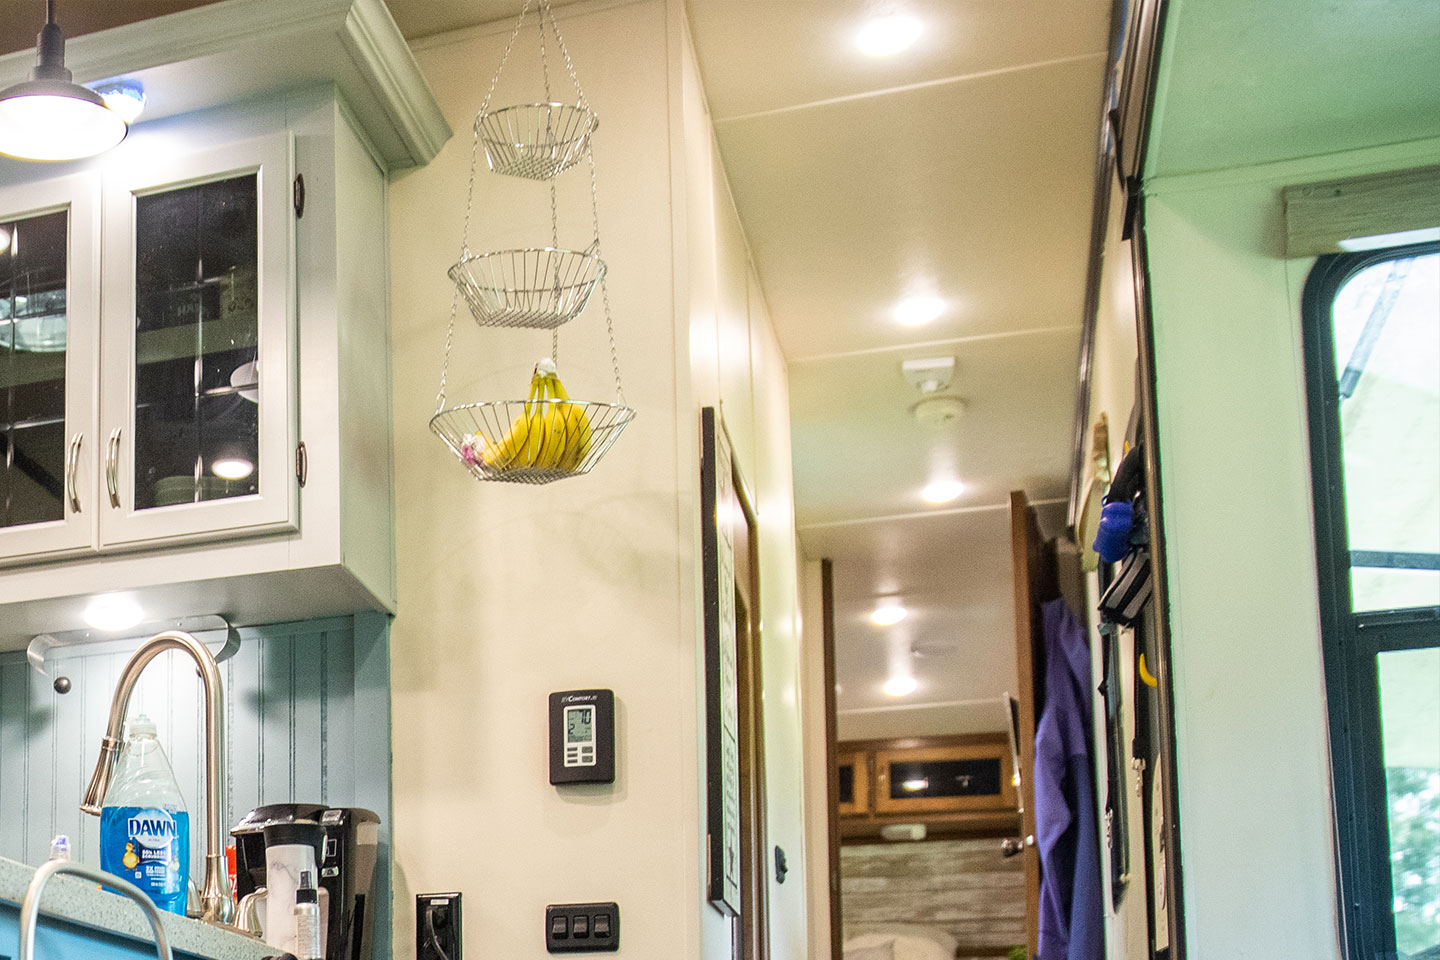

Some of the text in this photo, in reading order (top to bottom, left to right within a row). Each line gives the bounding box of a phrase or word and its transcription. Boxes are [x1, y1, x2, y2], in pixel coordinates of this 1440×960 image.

[579, 709, 592, 724] 70
[568, 723, 576, 734] 2
[128, 819, 177, 837] DAWN
